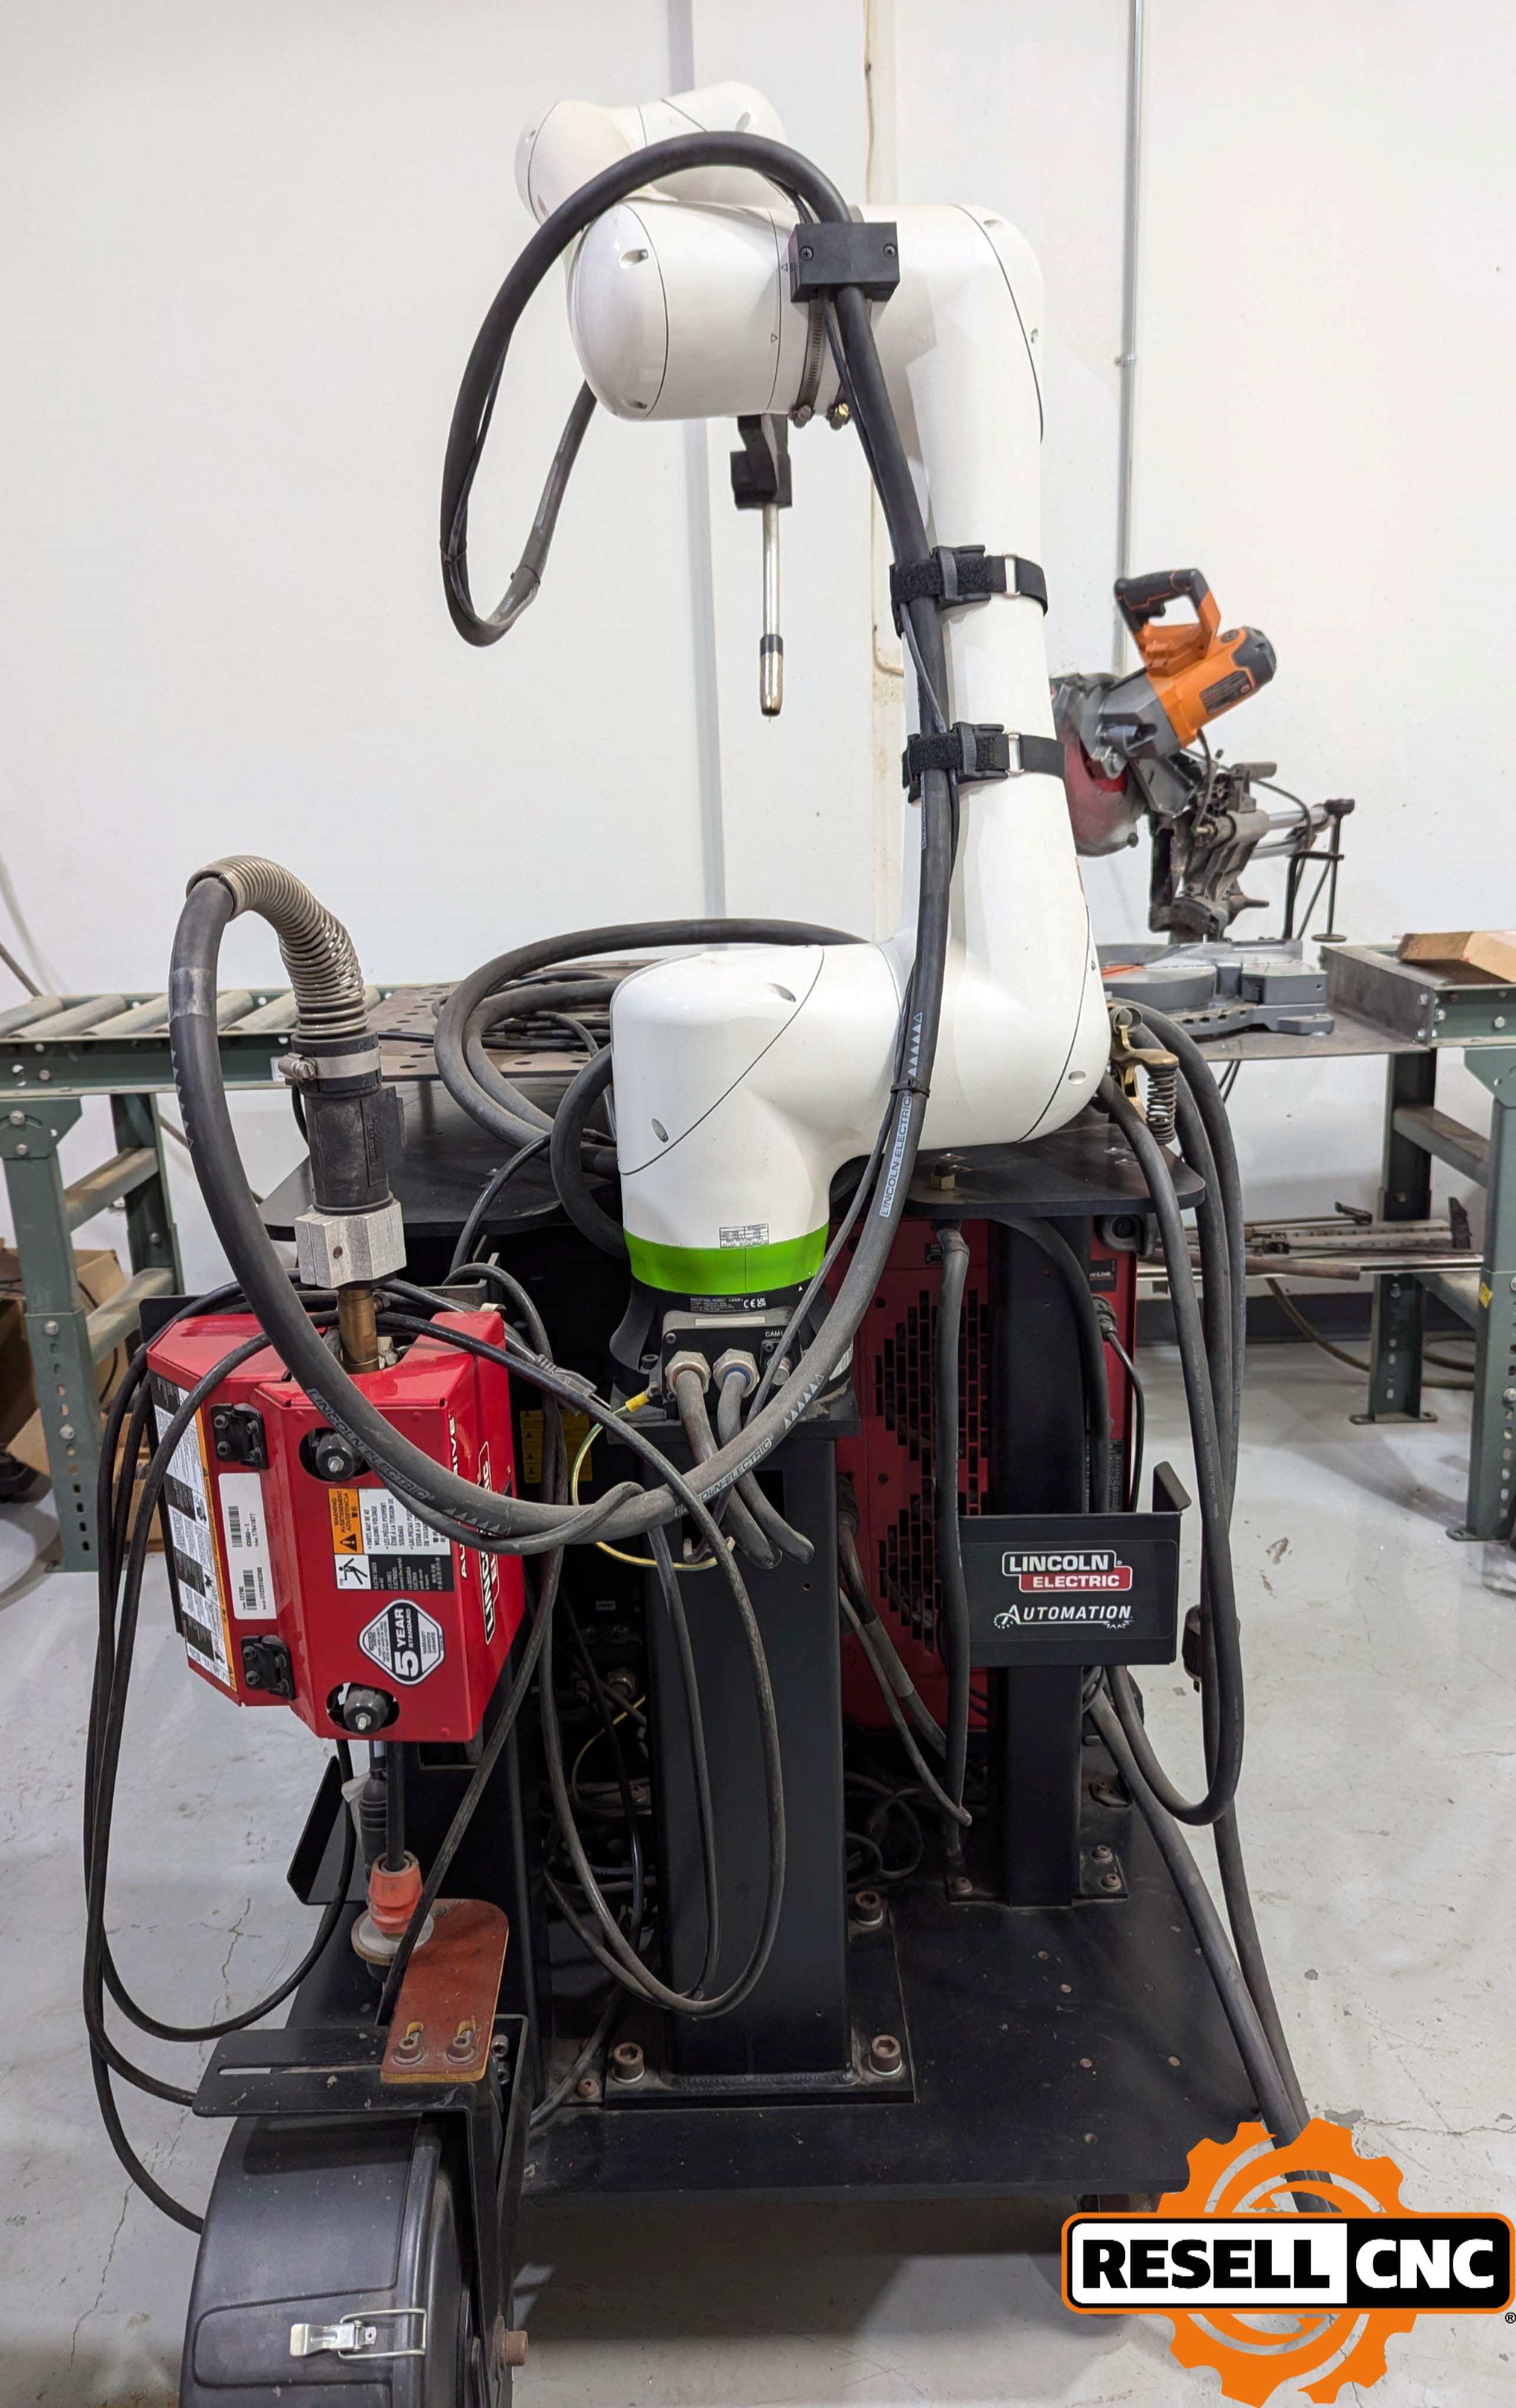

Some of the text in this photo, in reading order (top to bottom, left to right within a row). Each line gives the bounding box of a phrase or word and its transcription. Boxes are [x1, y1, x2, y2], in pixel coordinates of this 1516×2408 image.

[881, 1097, 911, 1216] LINCOLN ELECTRIC
[306, 1387, 429, 1500] LINCOLN ELECTRIC
[724, 1438, 772, 1484] ELECTRIC
[337, 1490, 346, 1533] AVERTISSEMENT
[344, 1493, 352, 1531] ADVERTENCIA
[1009, 1555, 1109, 1572] LINCOLN
[1033, 1575, 1120, 1588] ELECTRIC
[1002, 1605, 1131, 1624] AUTOMATION
[394, 1608, 419, 1677] 5 YEAR
